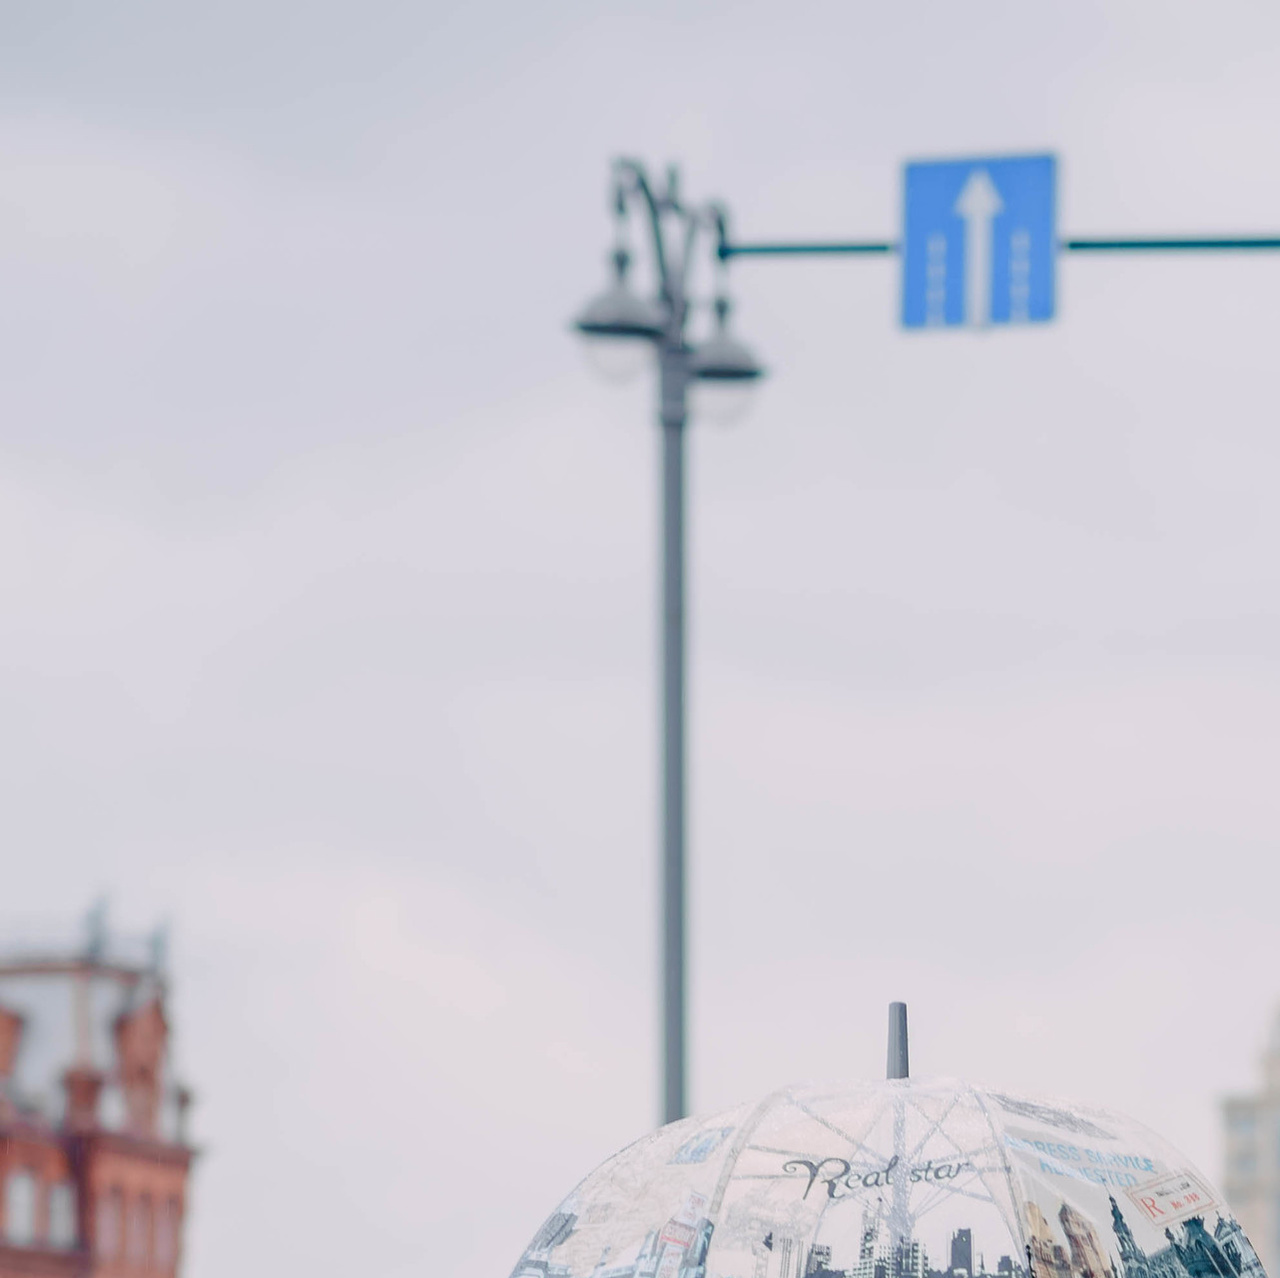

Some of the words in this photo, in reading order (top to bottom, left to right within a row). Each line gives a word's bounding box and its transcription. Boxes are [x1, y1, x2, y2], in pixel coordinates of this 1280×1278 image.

[783, 1155, 900, 1201] Real
[909, 1159, 970, 1184] star
[1140, 1197, 1165, 1218] R
